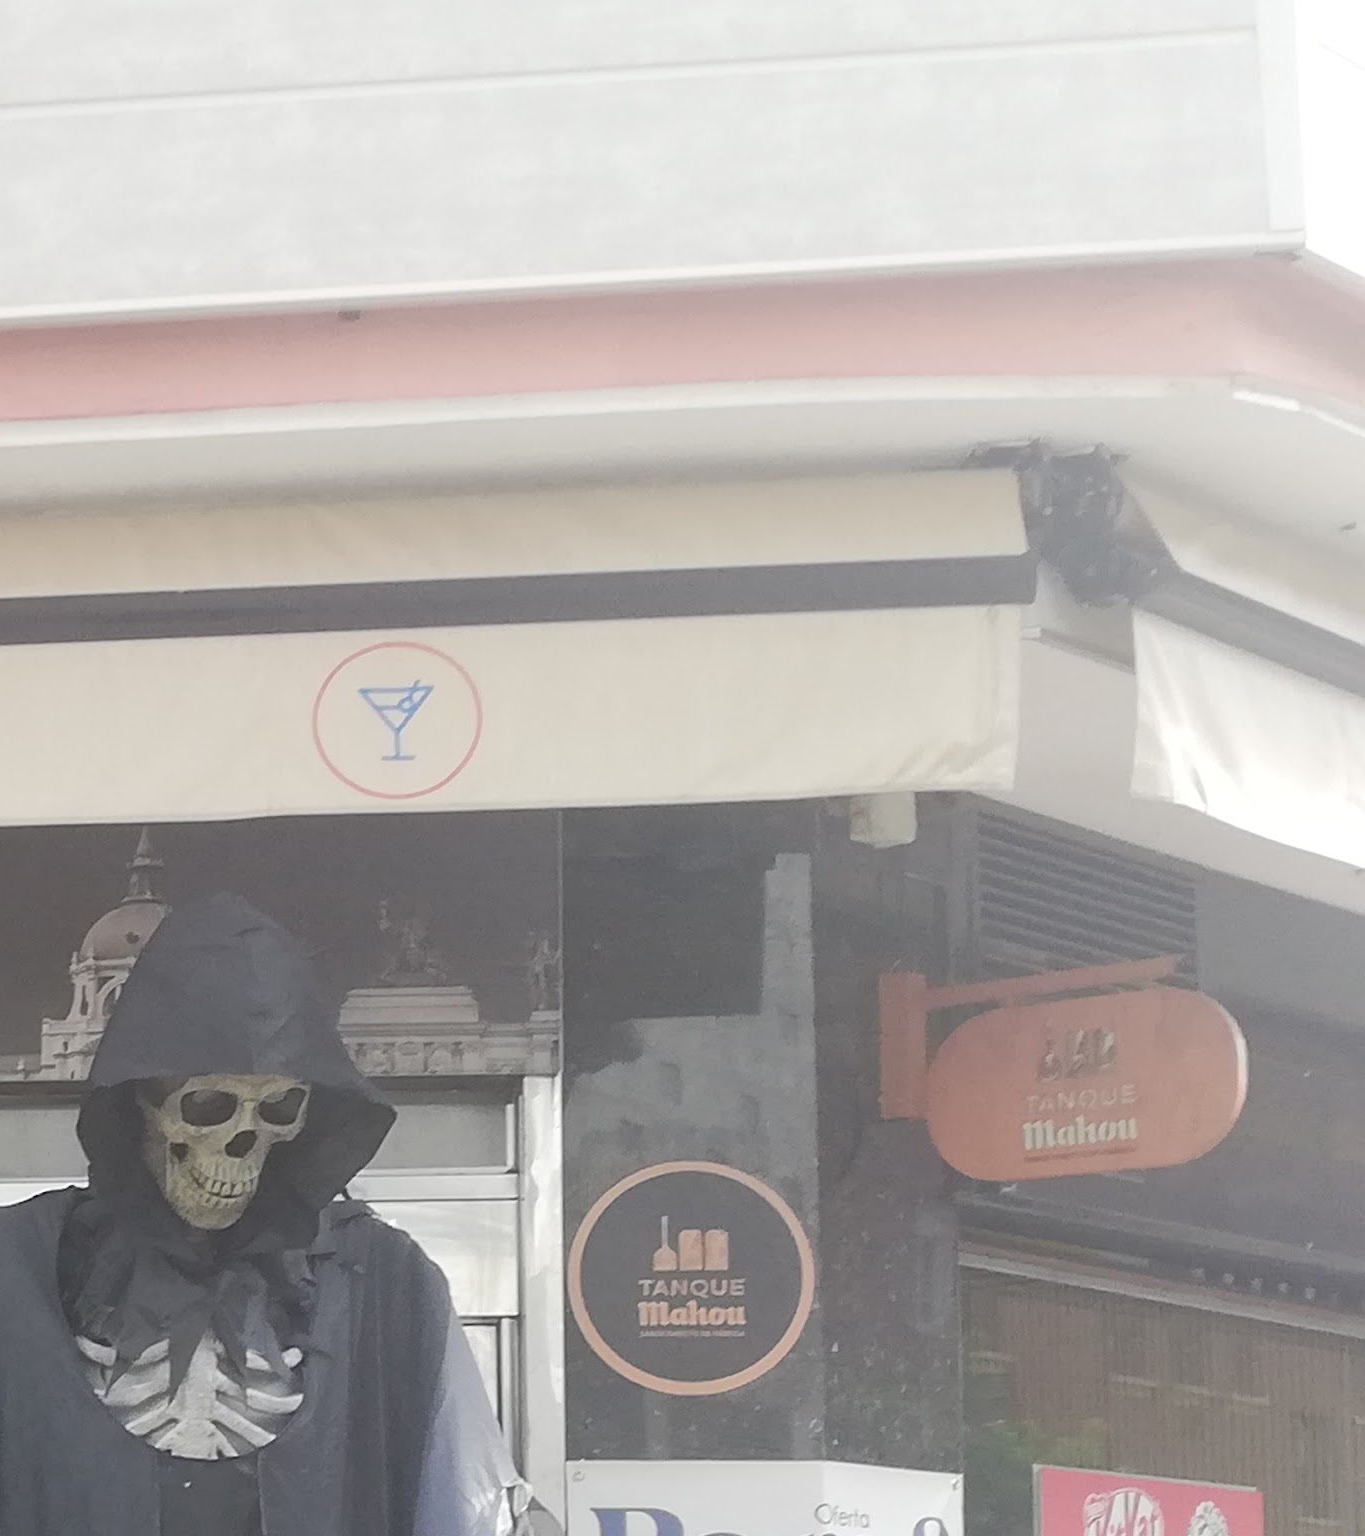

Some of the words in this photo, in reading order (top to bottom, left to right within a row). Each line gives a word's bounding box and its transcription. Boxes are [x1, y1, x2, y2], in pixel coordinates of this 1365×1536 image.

[1025, 1084, 1138, 1112] TANQUE
[1022, 1114, 1138, 1151] Mahou
[637, 1278, 746, 1299] TANQUE
[637, 1299, 747, 1327] Mahou
[814, 1502, 870, 1529] Oferta
